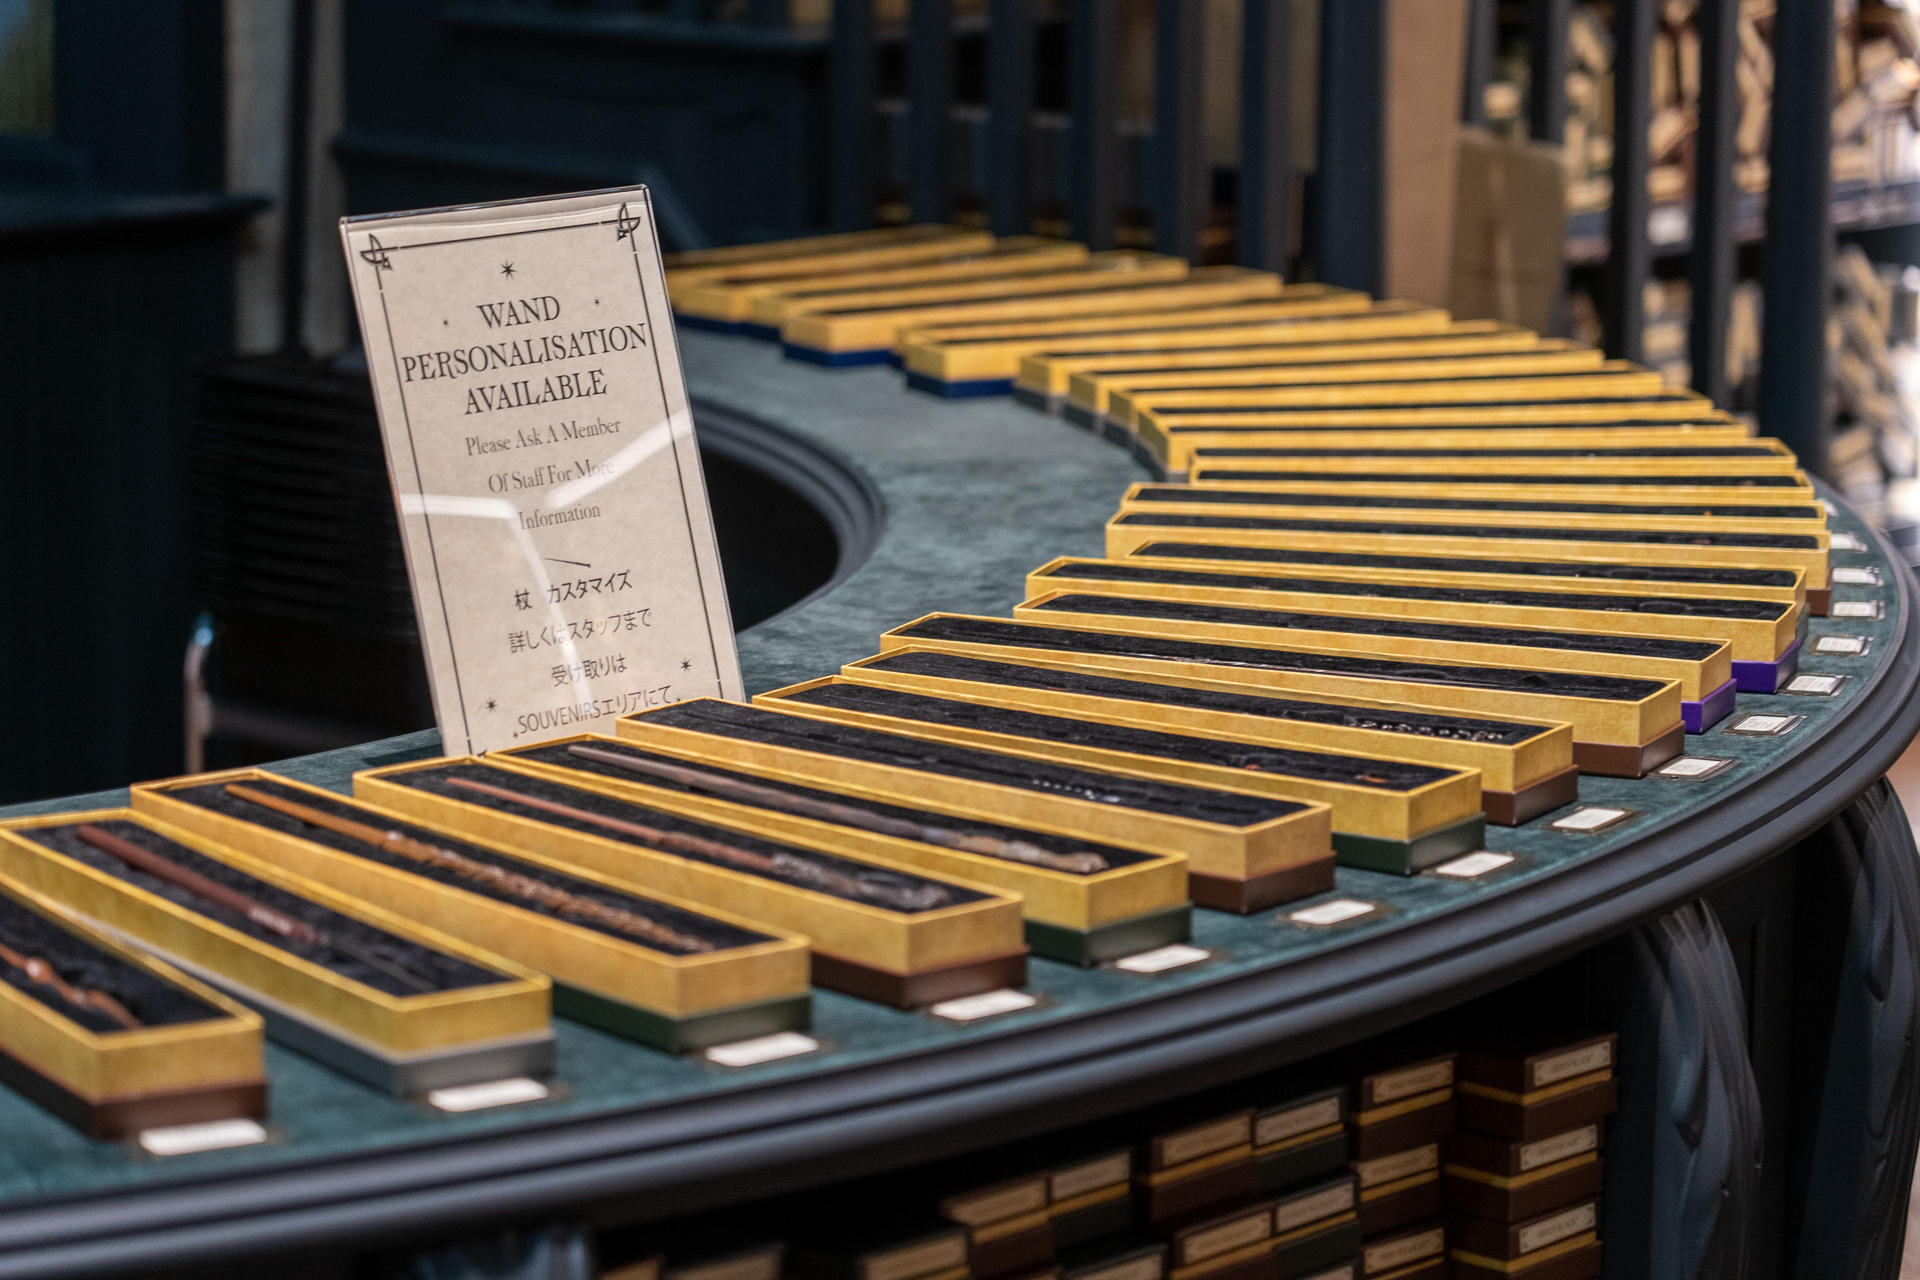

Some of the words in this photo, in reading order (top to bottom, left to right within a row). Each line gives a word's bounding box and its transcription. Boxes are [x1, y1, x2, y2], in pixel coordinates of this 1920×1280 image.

[477, 296, 561, 329] WAND
[402, 323, 648, 383] PERSONALISATION
[464, 368, 608, 416] AVAILABLE
[465, 434, 511, 457] Please
[516, 429, 543, 450] Ask
[547, 426, 559, 444] A
[561, 418, 621, 441] Member
[488, 471, 511, 494] Of
[512, 467, 545, 490] Staff
[549, 463, 572, 485] For
[576, 458, 615, 480] More
[518, 504, 602, 531] Information
[514, 589, 533, 612] 杖
[547, 569, 633, 604] カスタマイズ
[508, 608, 653, 654] 詳しくはスタッフまで
[551, 653, 628, 687] 受け取りは
